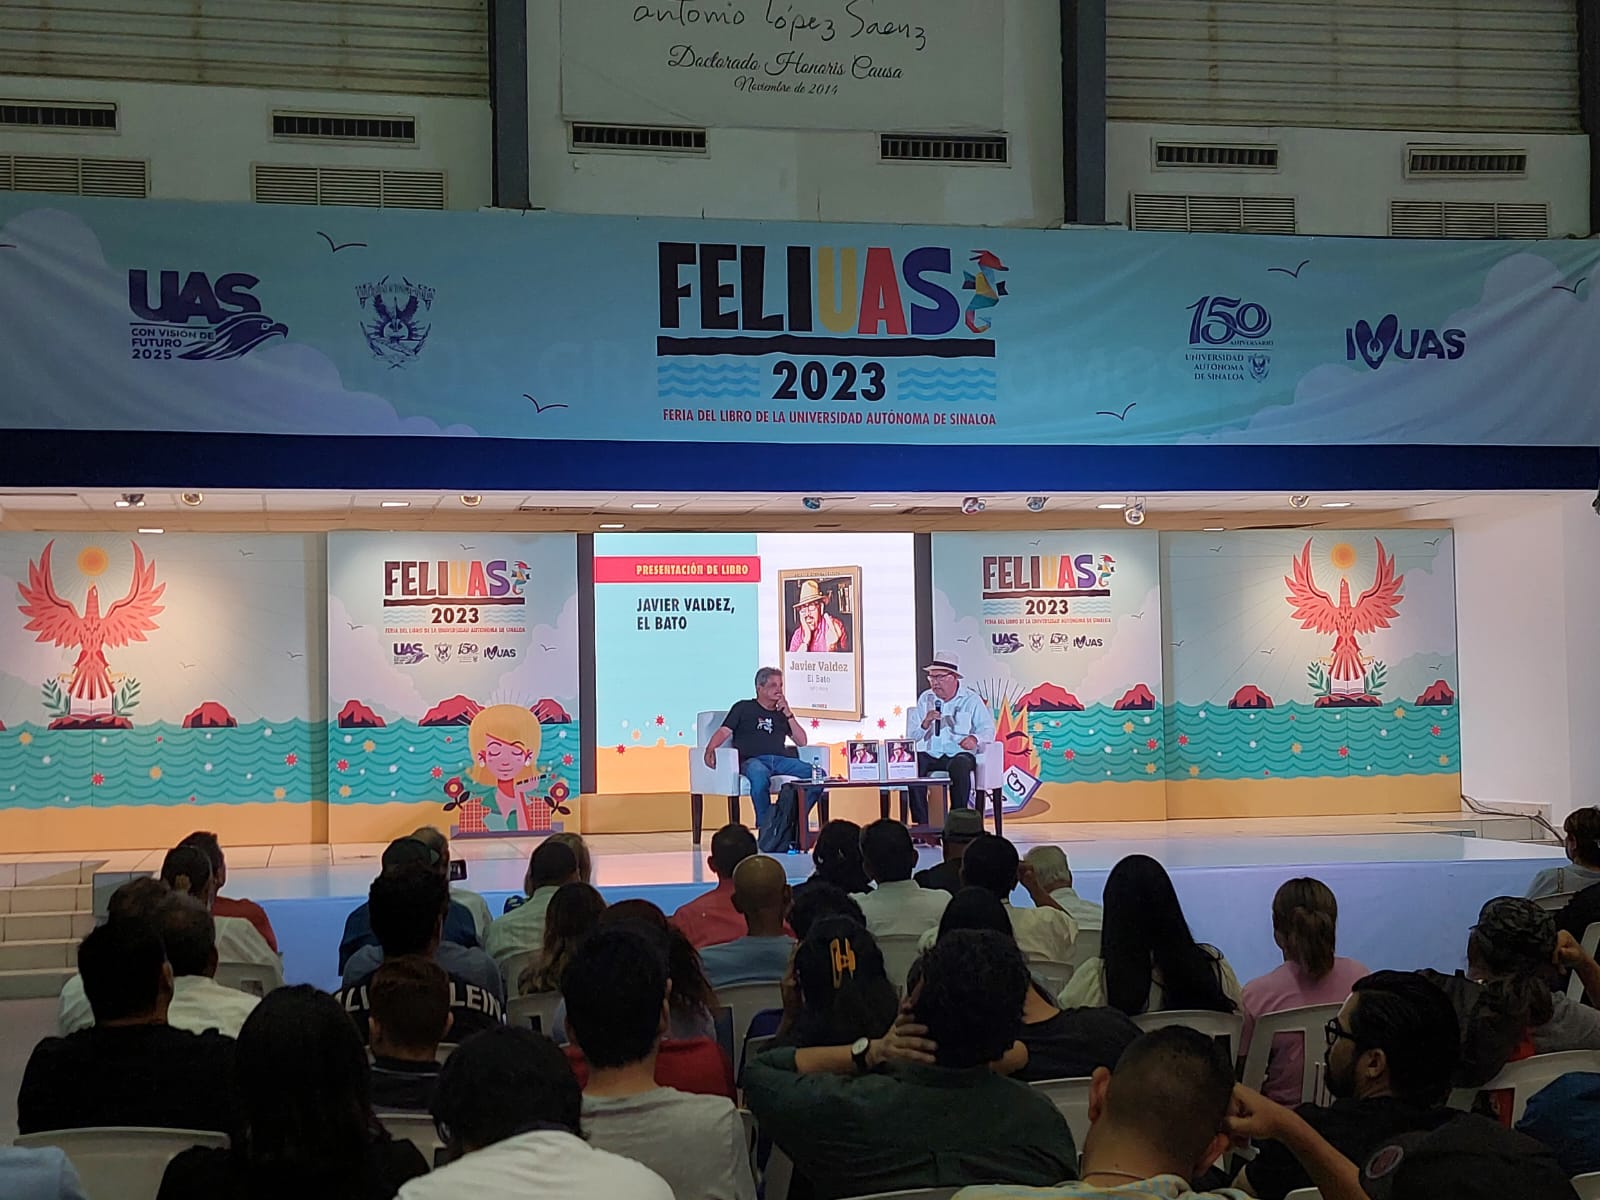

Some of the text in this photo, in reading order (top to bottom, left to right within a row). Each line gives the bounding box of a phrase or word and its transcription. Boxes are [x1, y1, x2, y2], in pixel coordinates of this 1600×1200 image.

[668, 45, 903, 79] Doctorado Honoris Causa
[734, 75, 838, 95] Noviembre de 2014
[658, 242, 961, 335] FELIUAS
[129, 269, 261, 324] UAS
[1186, 295, 1272, 345] 150
[131, 328, 215, 341] CON VISIÓN DE
[131, 338, 182, 348] FUTURO
[1394, 329, 1466, 360] UAS
[131, 349, 172, 360] 2025
[1185, 353, 1244, 361] UNIVERSIDAD
[772, 360, 886, 401] 2023
[1195, 373, 1245, 381] DE SINALOA
[663, 408, 997, 425] FERIA DEL LIBRO DE LA UNIVERSIDAD AUTÓNOMA DE SINALOA
[636, 561, 749, 575] PRESENTACIÓN DE LIBRO
[983, 554, 1097, 590] FELIUAS
[384, 560, 511, 596] FELIUAS
[637, 598, 735, 614] JAVIER VALDEZ,
[1025, 599, 1069, 615] 2023
[431, 607, 480, 624] 2023
[637, 615, 688, 630] EL BATO
[992, 633, 1019, 645] UAS
[1085, 638, 1103, 647] UAS
[393, 643, 423, 655] UAS
[458, 643, 479, 654] 150
[497, 648, 517, 657] UAS
[790, 660, 849, 672] Javier Valdez
